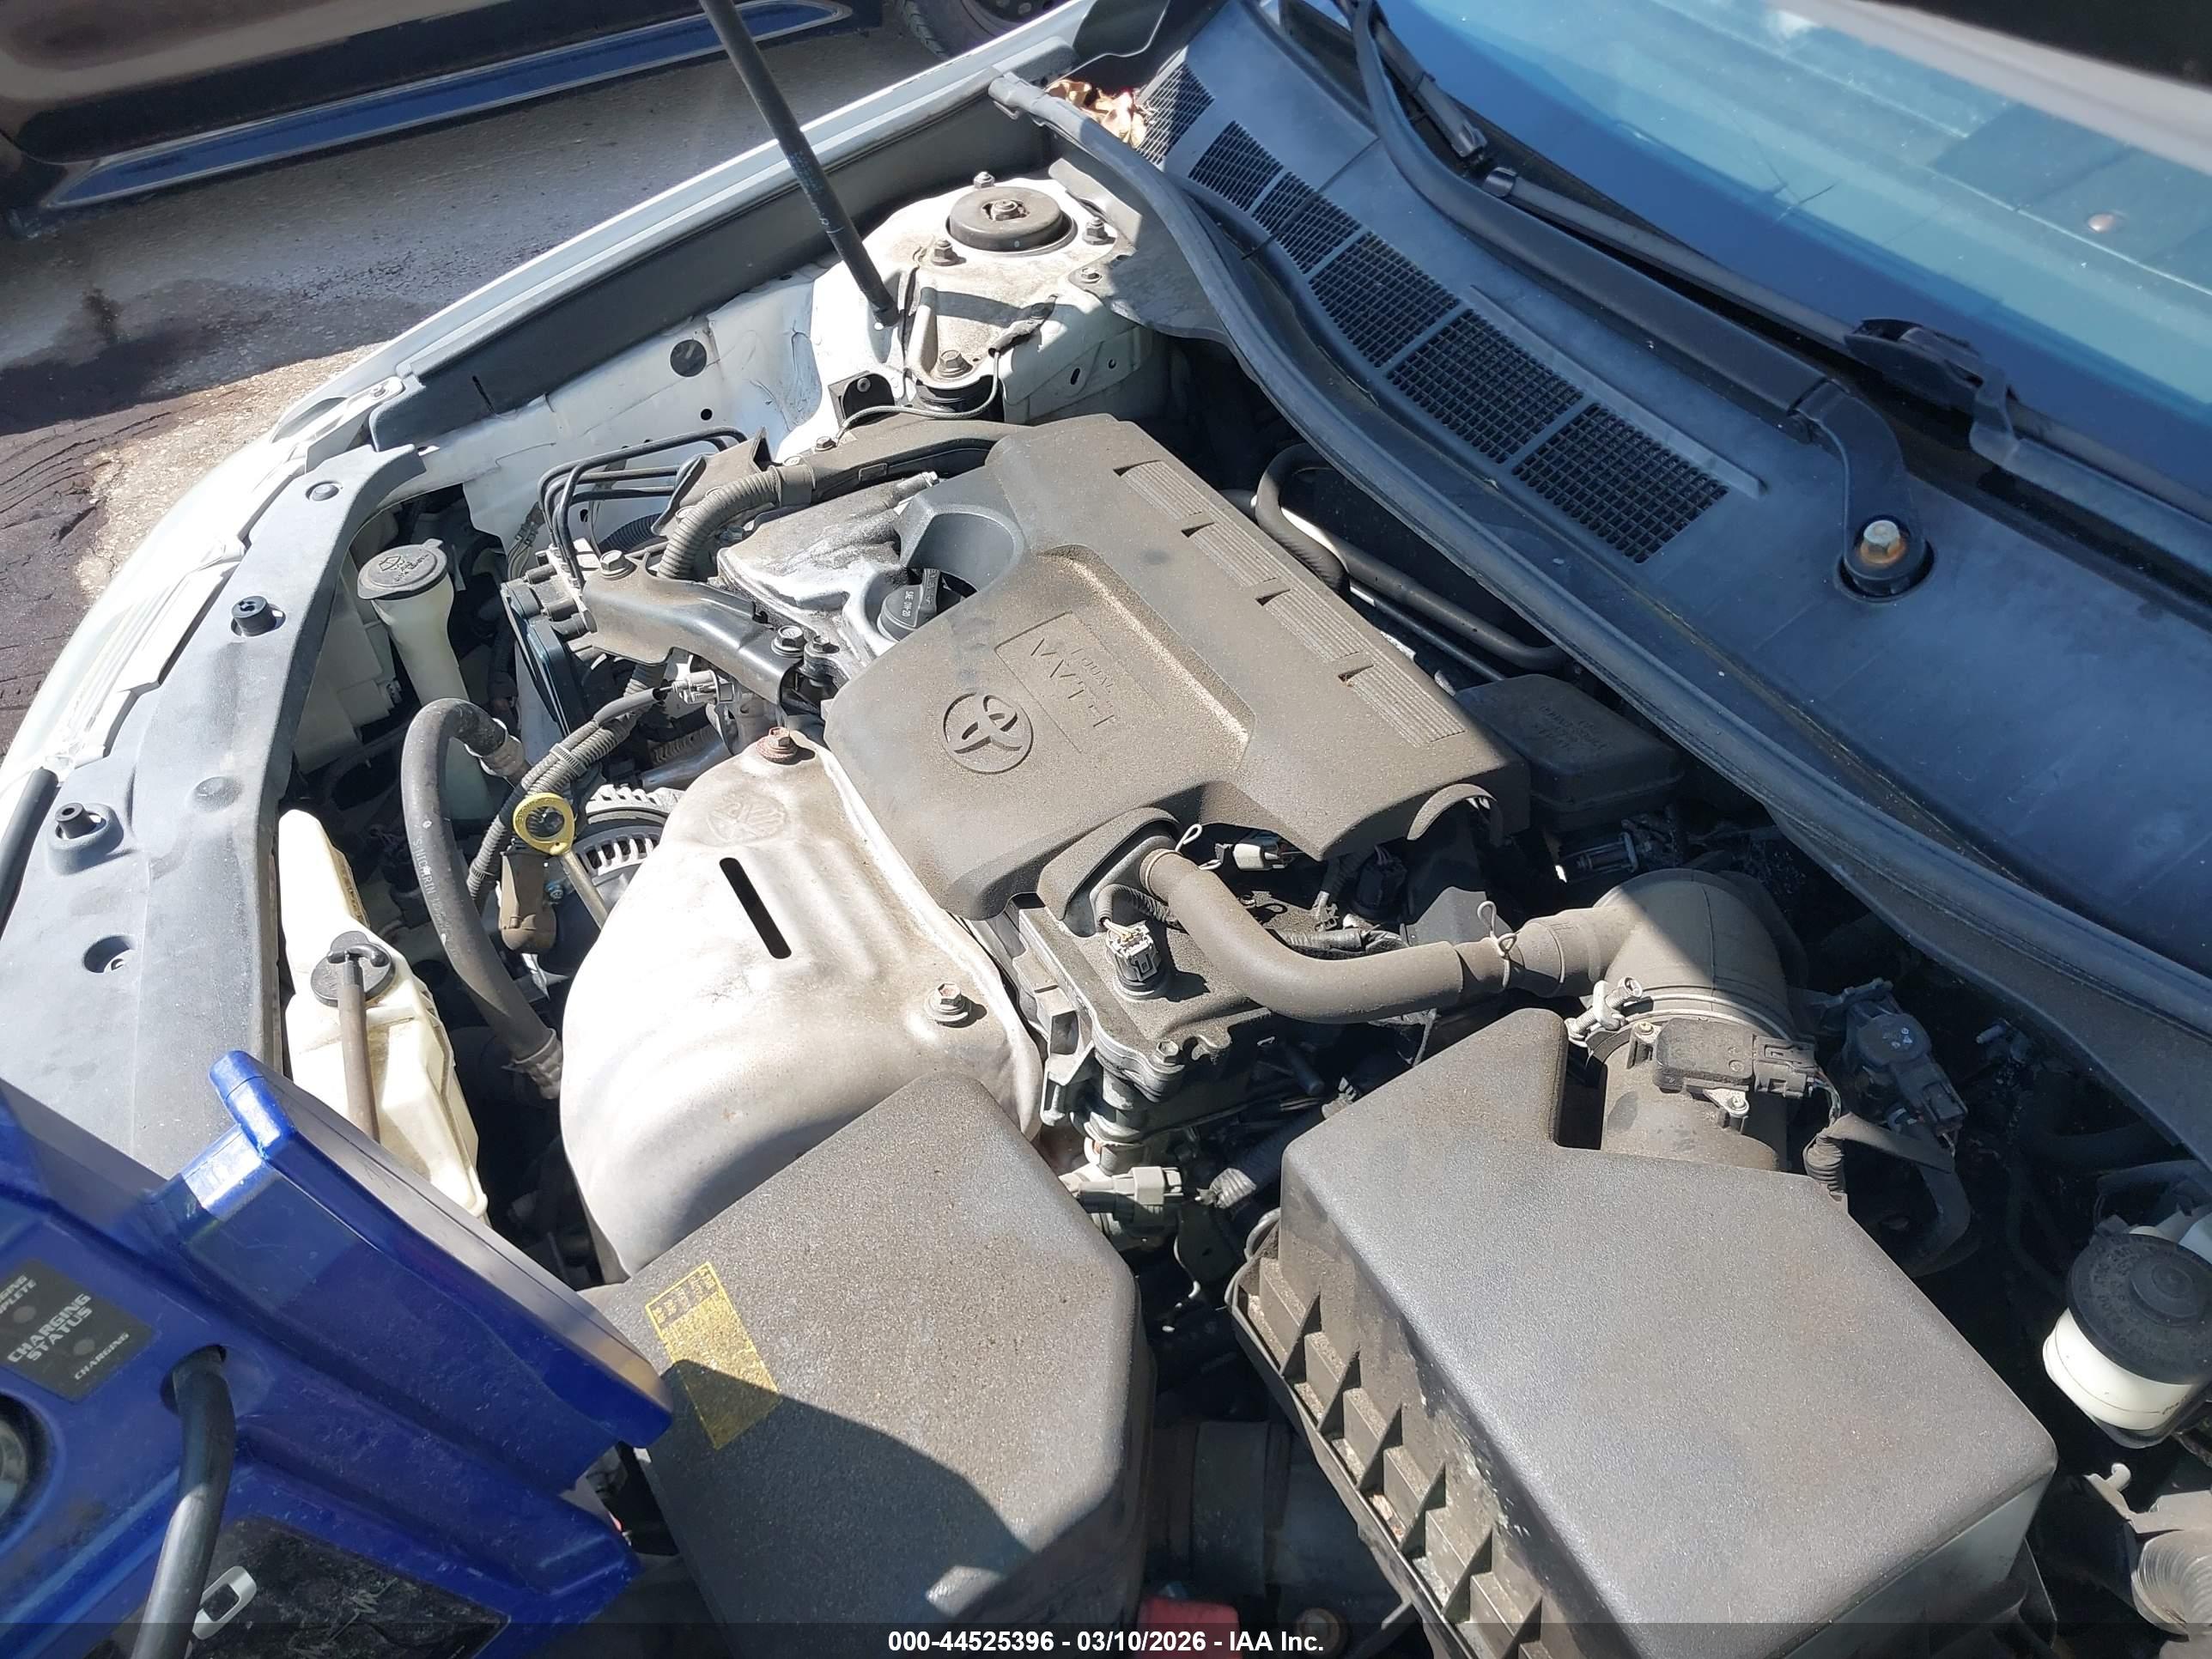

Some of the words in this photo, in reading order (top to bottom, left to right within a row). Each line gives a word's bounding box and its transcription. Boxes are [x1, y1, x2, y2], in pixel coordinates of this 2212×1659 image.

[7, 1293, 92, 1363] CHARGING
[27, 1306, 93, 1361] STATUS
[74, 1332, 130, 1380] CHARGING
